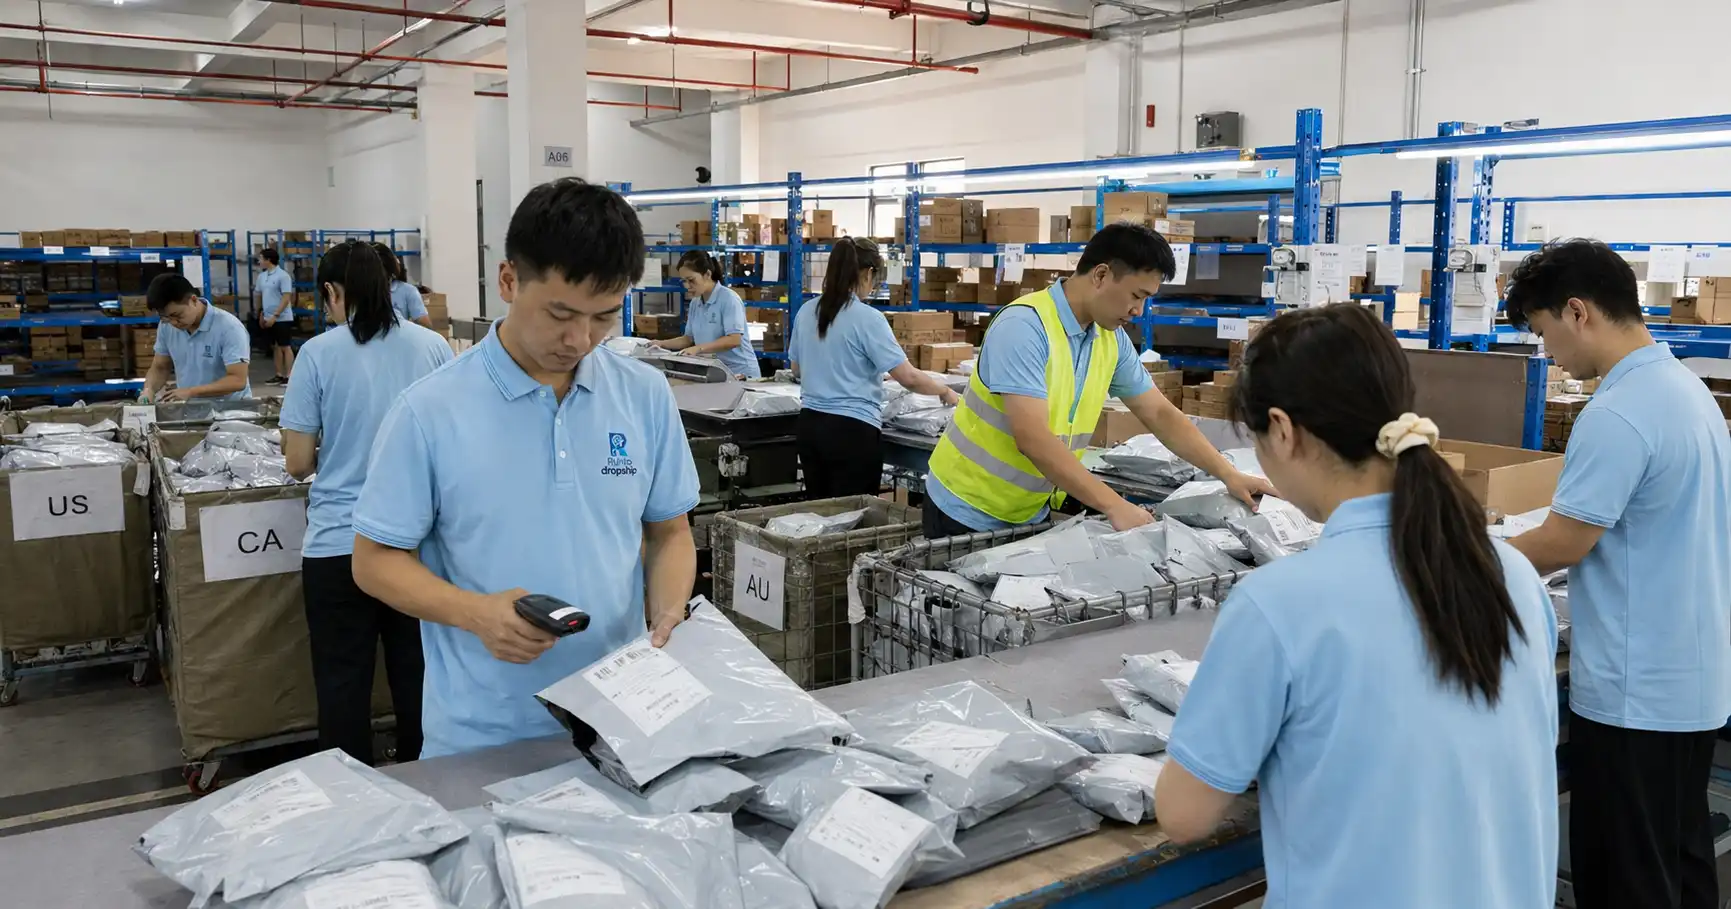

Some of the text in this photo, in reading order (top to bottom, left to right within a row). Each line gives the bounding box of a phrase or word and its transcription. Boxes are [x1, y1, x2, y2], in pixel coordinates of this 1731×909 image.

[548, 151, 569, 162] A06
[601, 466, 637, 476] dropship
[48, 494, 89, 516] US
[238, 528, 284, 554] CA
[746, 574, 770, 601] AU
